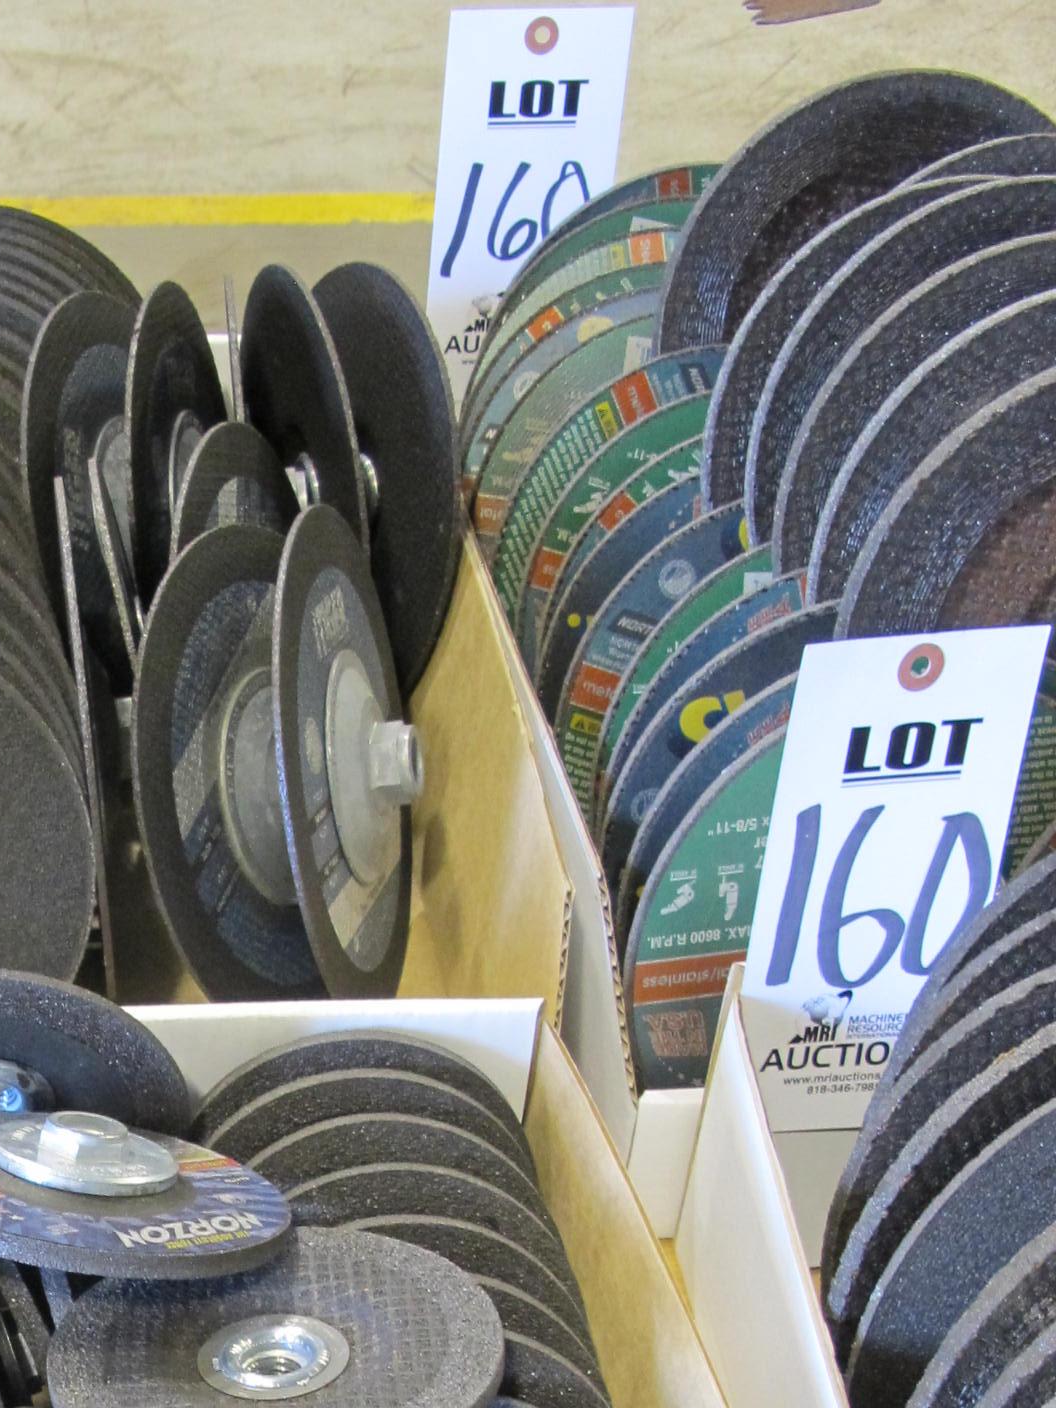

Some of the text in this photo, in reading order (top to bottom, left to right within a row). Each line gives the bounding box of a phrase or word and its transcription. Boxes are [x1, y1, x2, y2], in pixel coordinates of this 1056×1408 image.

[487, 79, 590, 119] LOT
[843, 717, 985, 775] LOT
[765, 803, 993, 989] 160
[647, 927, 751, 950] AX. 8600 R.P.M.
[848, 1013, 909, 1025] MACHINE
[803, 1024, 839, 1044] MRI
[759, 1041, 891, 1073] AUCTIO
[783, 1072, 882, 1086] www.mriauctions
[806, 1083, 879, 1095] 818-346-798
[114, 1210, 264, 1249] NORZON
